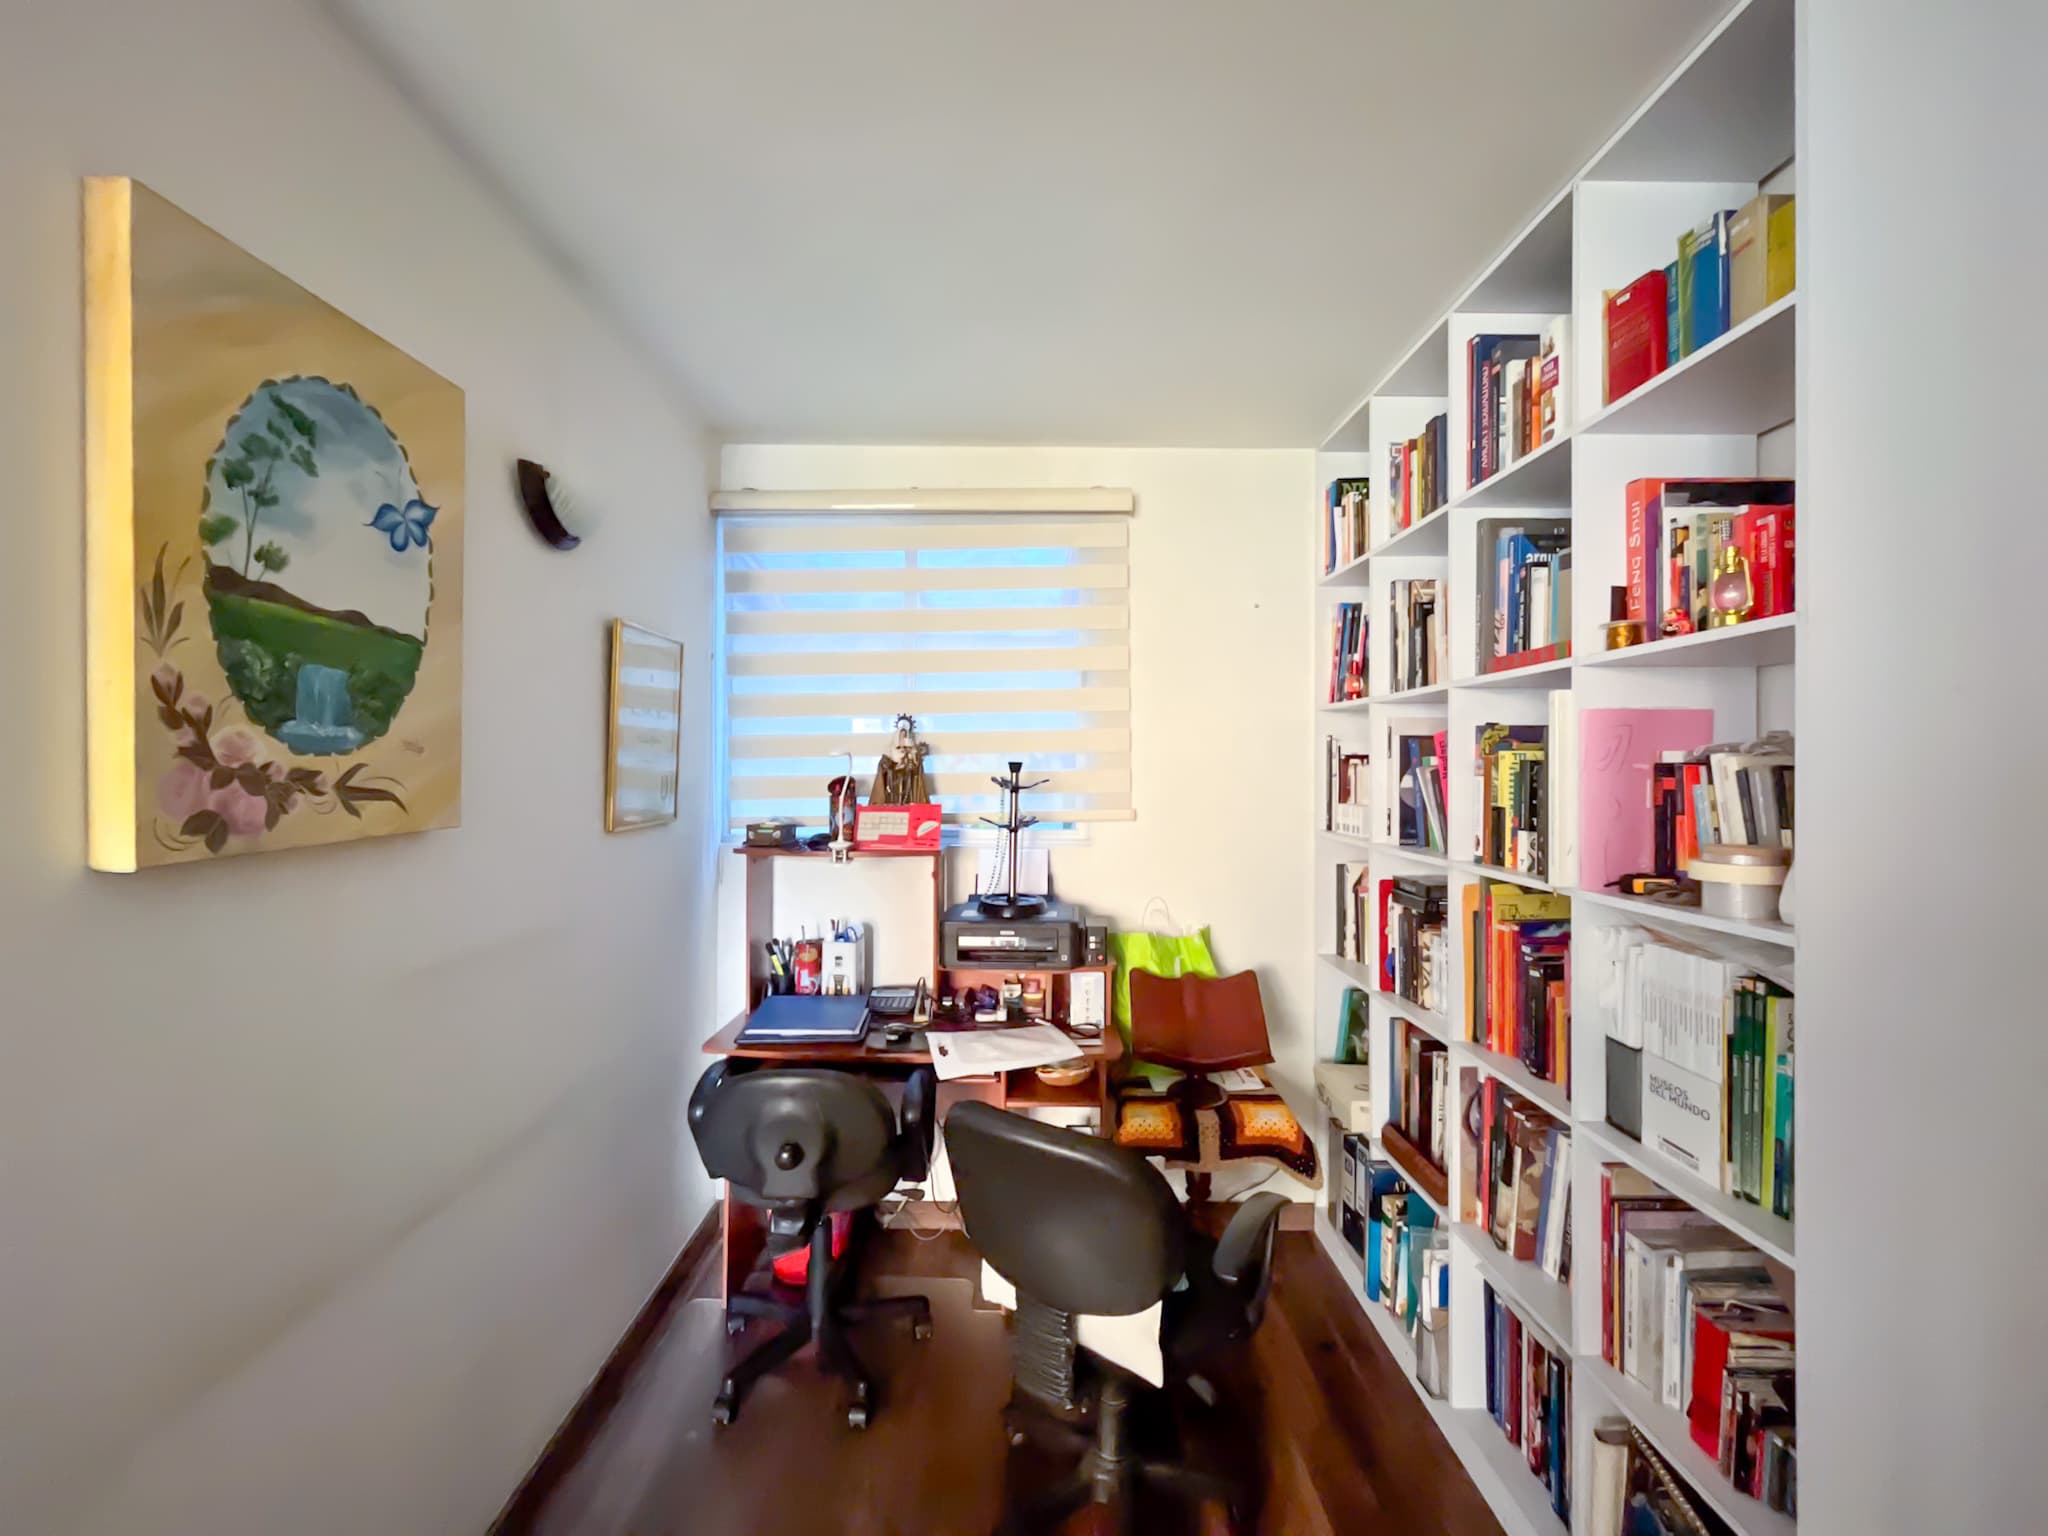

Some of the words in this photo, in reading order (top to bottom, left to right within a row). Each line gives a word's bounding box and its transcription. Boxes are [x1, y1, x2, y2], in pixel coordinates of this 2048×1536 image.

[1649, 1073, 1688, 1100] MUSEOS
[1649, 1081, 1666, 1100] DEL
[1668, 1092, 1711, 1121] MUNDO
